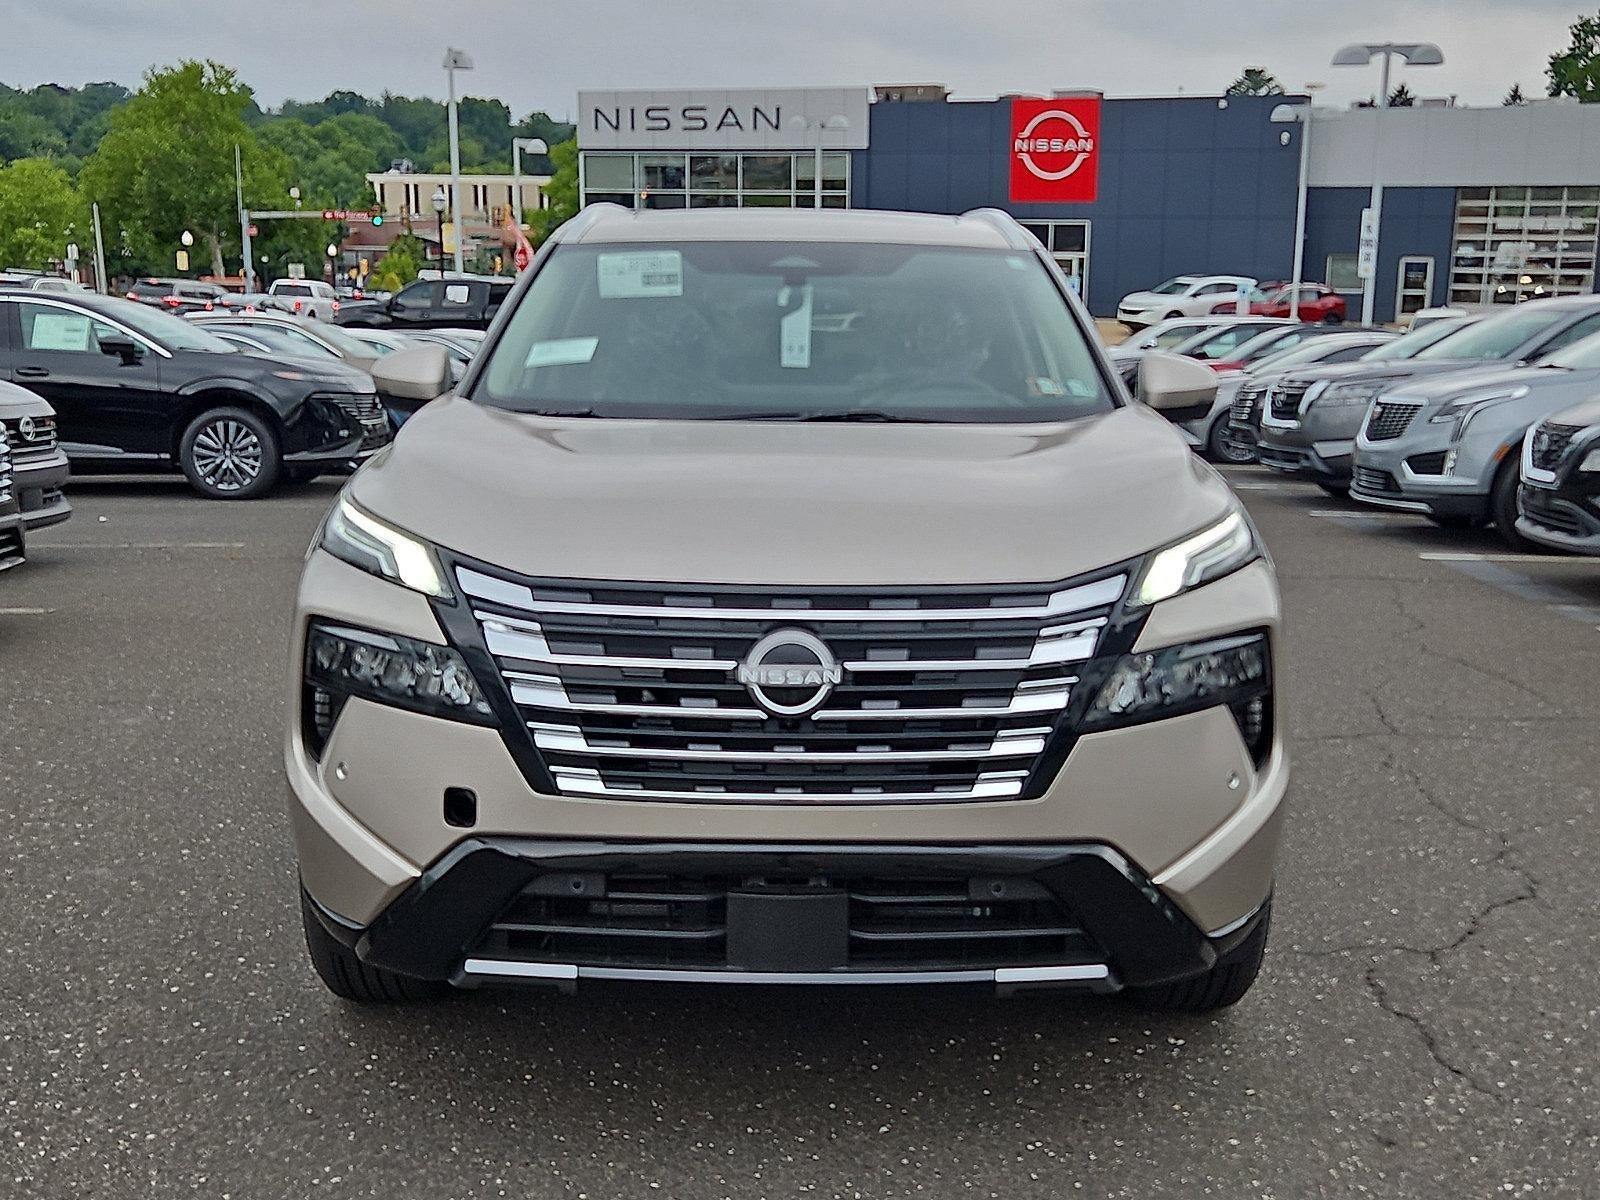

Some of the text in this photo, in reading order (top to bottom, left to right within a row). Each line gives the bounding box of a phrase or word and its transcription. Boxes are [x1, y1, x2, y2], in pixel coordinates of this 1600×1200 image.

[593, 106, 781, 131] NISSAN
[1014, 138, 1094, 153] NISSAN
[740, 667, 841, 685] NISSAN
